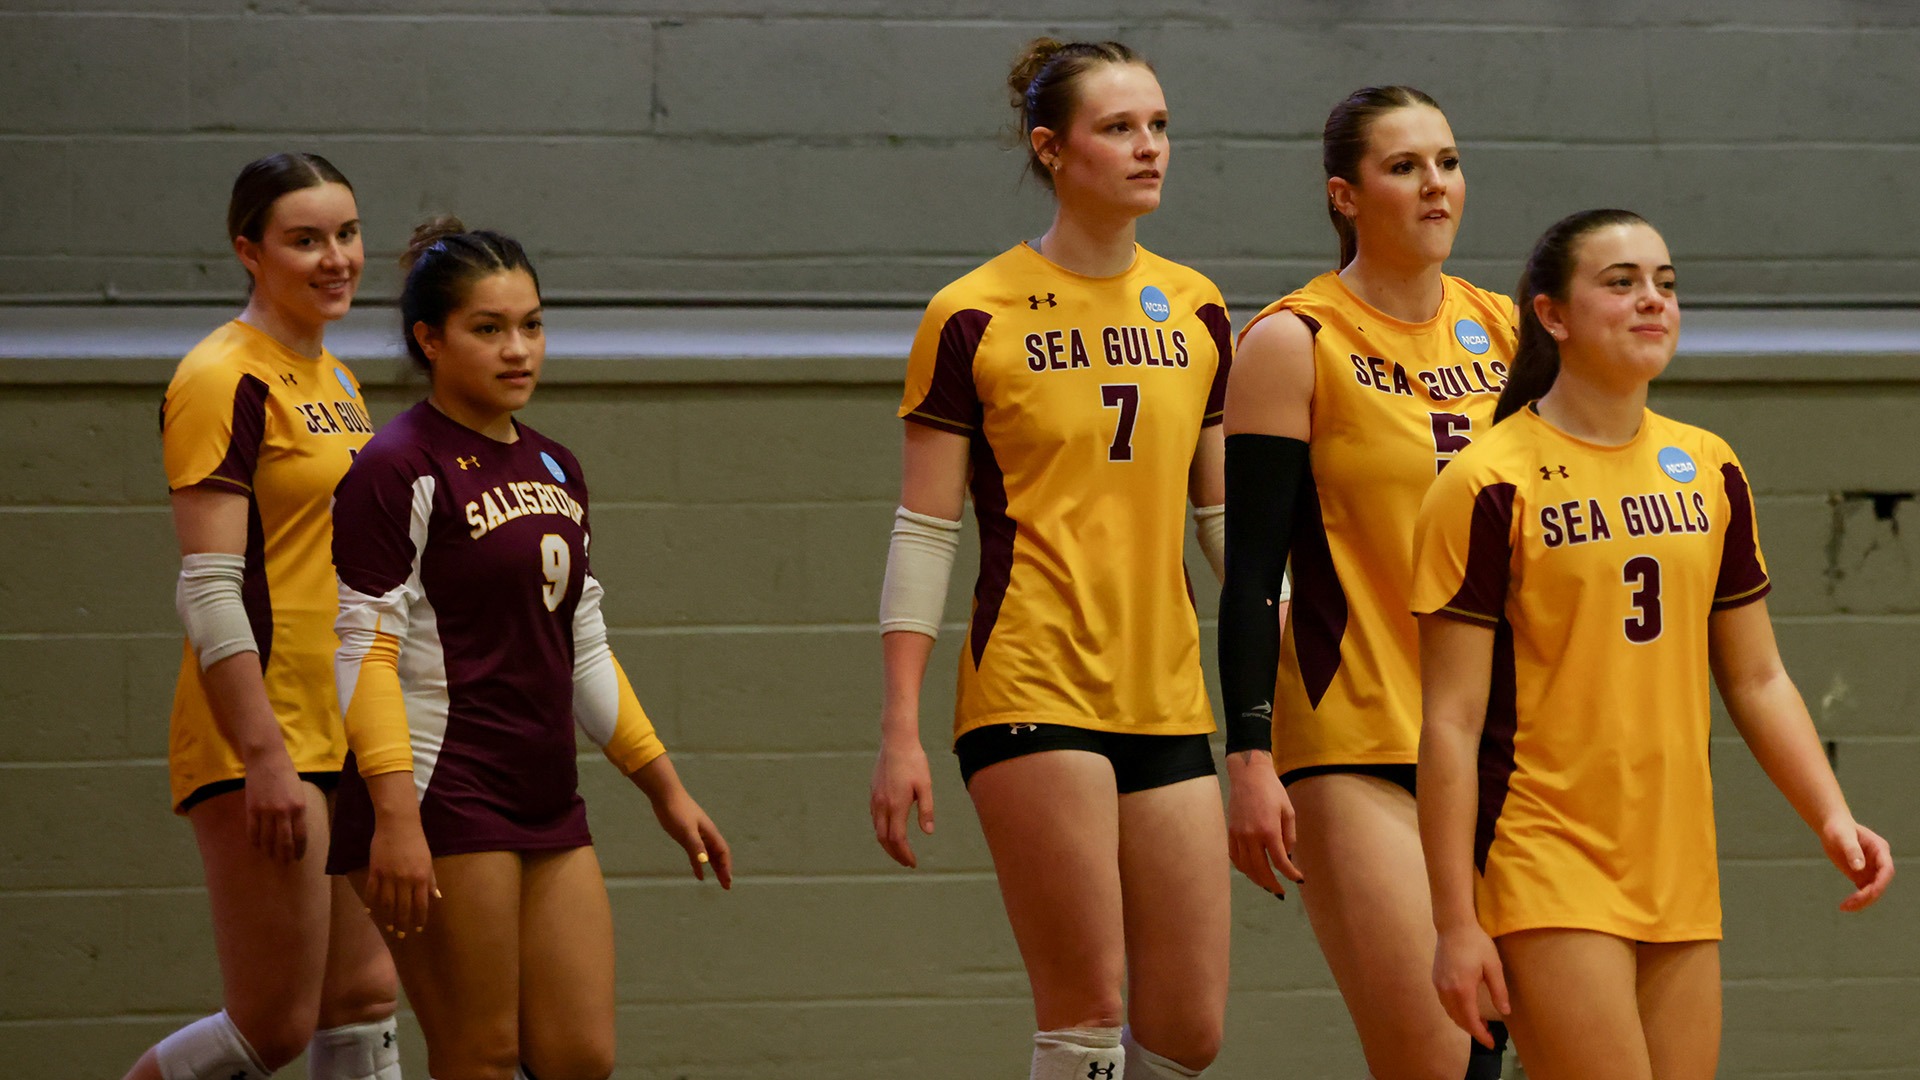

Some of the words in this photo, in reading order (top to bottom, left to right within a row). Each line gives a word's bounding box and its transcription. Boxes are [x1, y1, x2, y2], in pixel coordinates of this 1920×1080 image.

[1145, 301, 1169, 314] NCAA
[1024, 328, 1091, 373] SEA
[1101, 326, 1190, 368] GULLS
[1461, 335, 1489, 345] NCAA
[1350, 353, 1414, 396] SEA
[1418, 360, 1508, 401] GULLS
[294, 401, 343, 435] SEA
[1100, 383, 1140, 462] 7
[1665, 461, 1695, 474] NCAA
[465, 481, 585, 540] SALISBUR
[1540, 498, 1612, 548] SEA
[1620, 491, 1710, 537] GULLS
[539, 533, 571, 612] 9
[1622, 554, 1663, 644] 3
